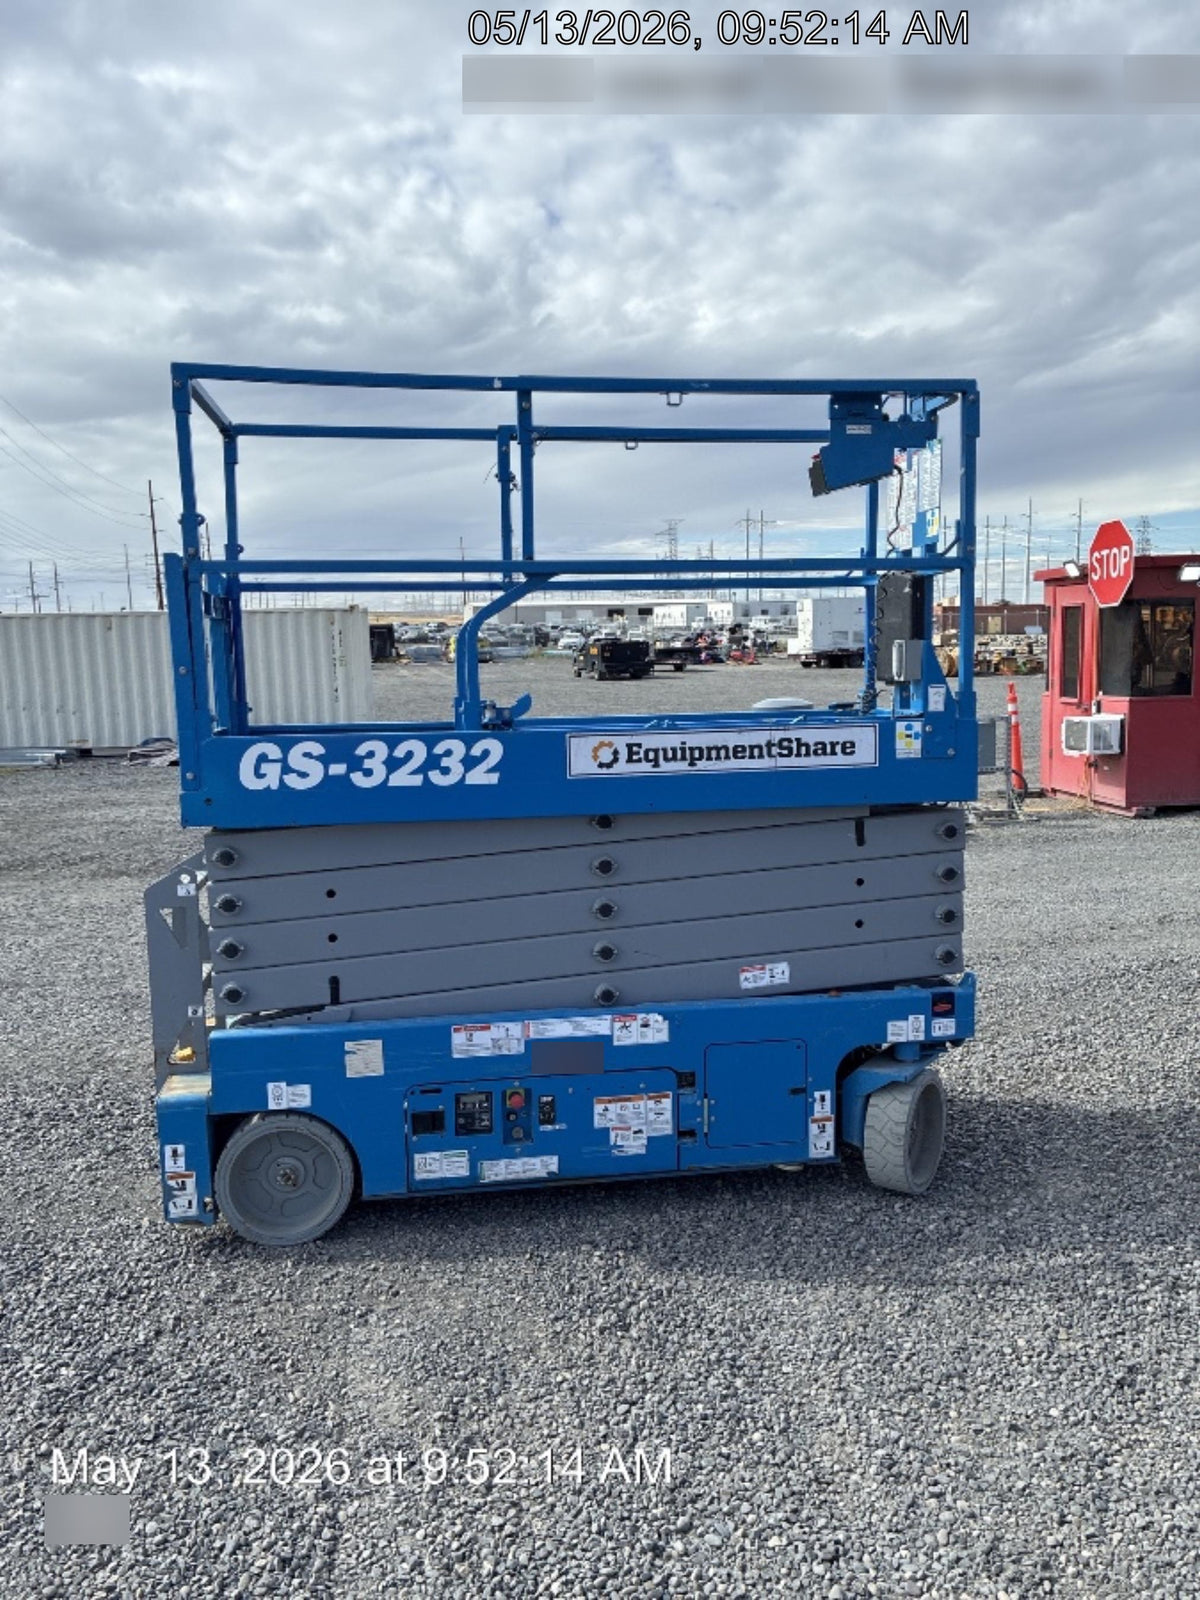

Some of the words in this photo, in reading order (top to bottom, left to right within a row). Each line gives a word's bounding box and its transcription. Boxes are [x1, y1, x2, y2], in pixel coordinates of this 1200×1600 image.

[1090, 545, 1130, 581] STOP
[239, 738, 504, 791] GS-3232
[625, 736, 856, 769] EquipmentShare
